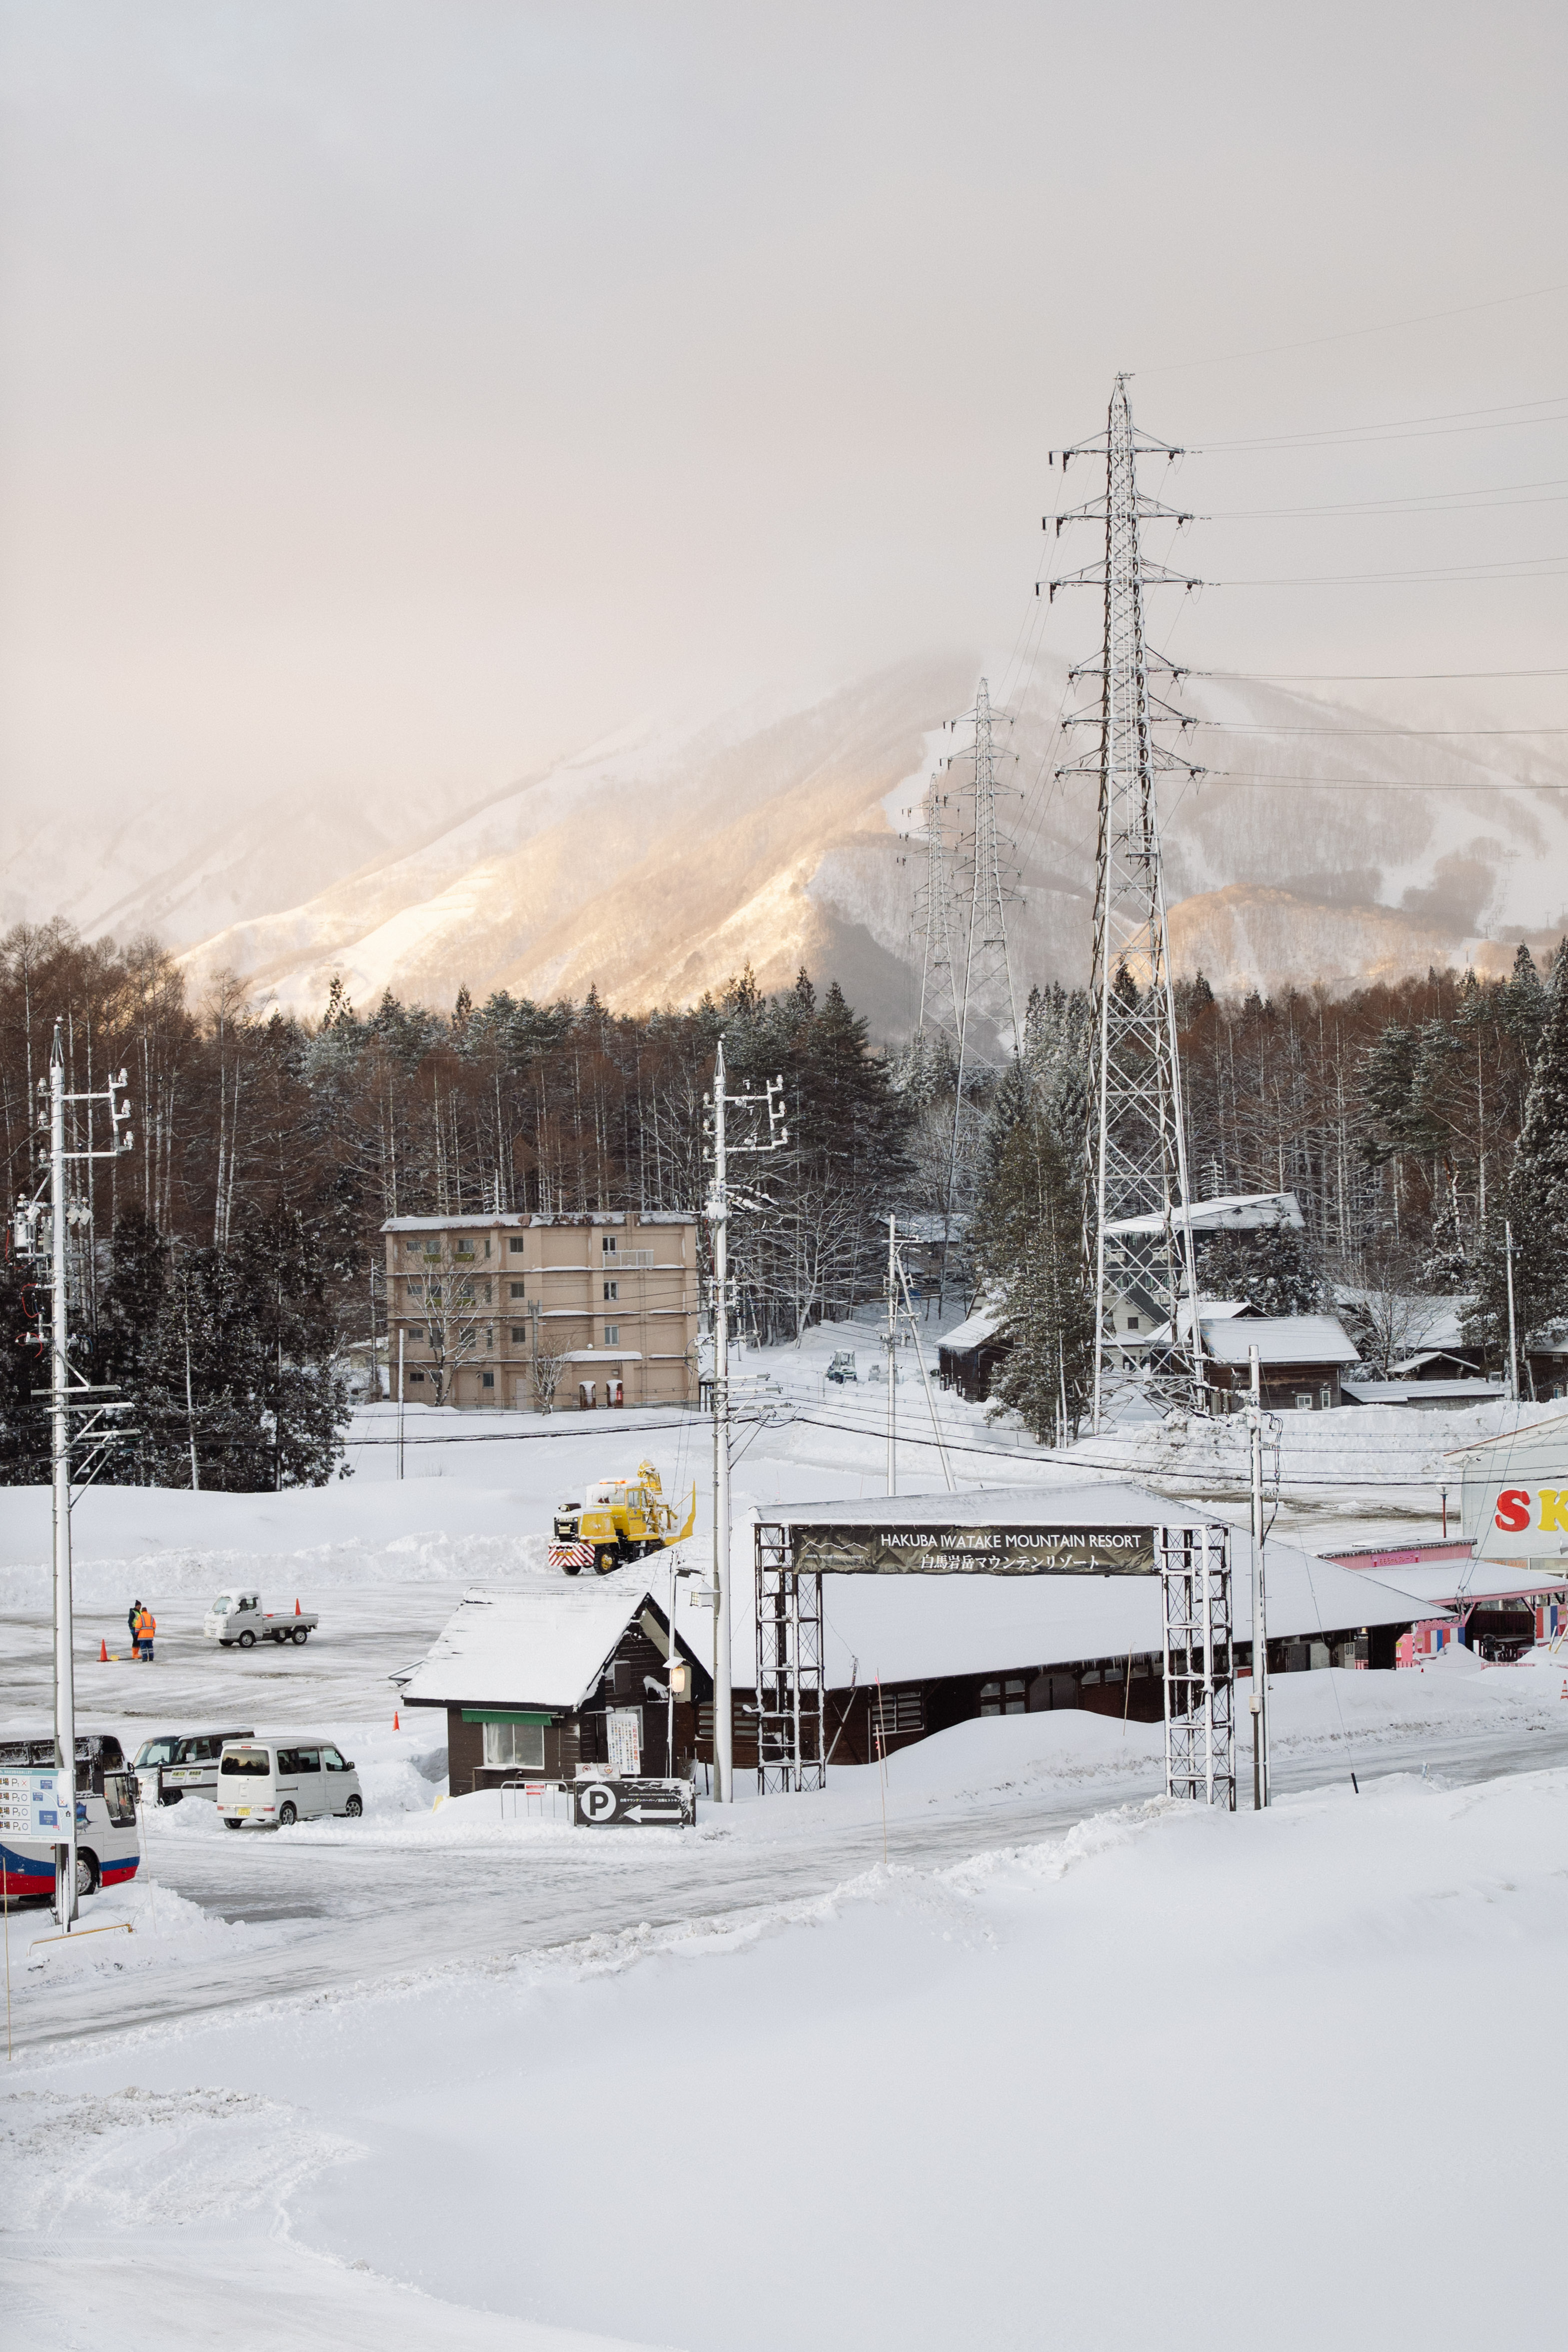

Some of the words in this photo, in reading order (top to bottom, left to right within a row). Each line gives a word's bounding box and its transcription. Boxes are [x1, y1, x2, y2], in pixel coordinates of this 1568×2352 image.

[881, 1534, 938, 1547] HAKUBA
[941, 1535, 1002, 1548] IWATAKE
[1005, 1535, 1085, 1548] MOUNTAIN
[1089, 1535, 1141, 1548] RESORT
[921, 1554, 1099, 1570] 白馬岩岳マウンテンリゾート
[590, 1791, 608, 1816] P
